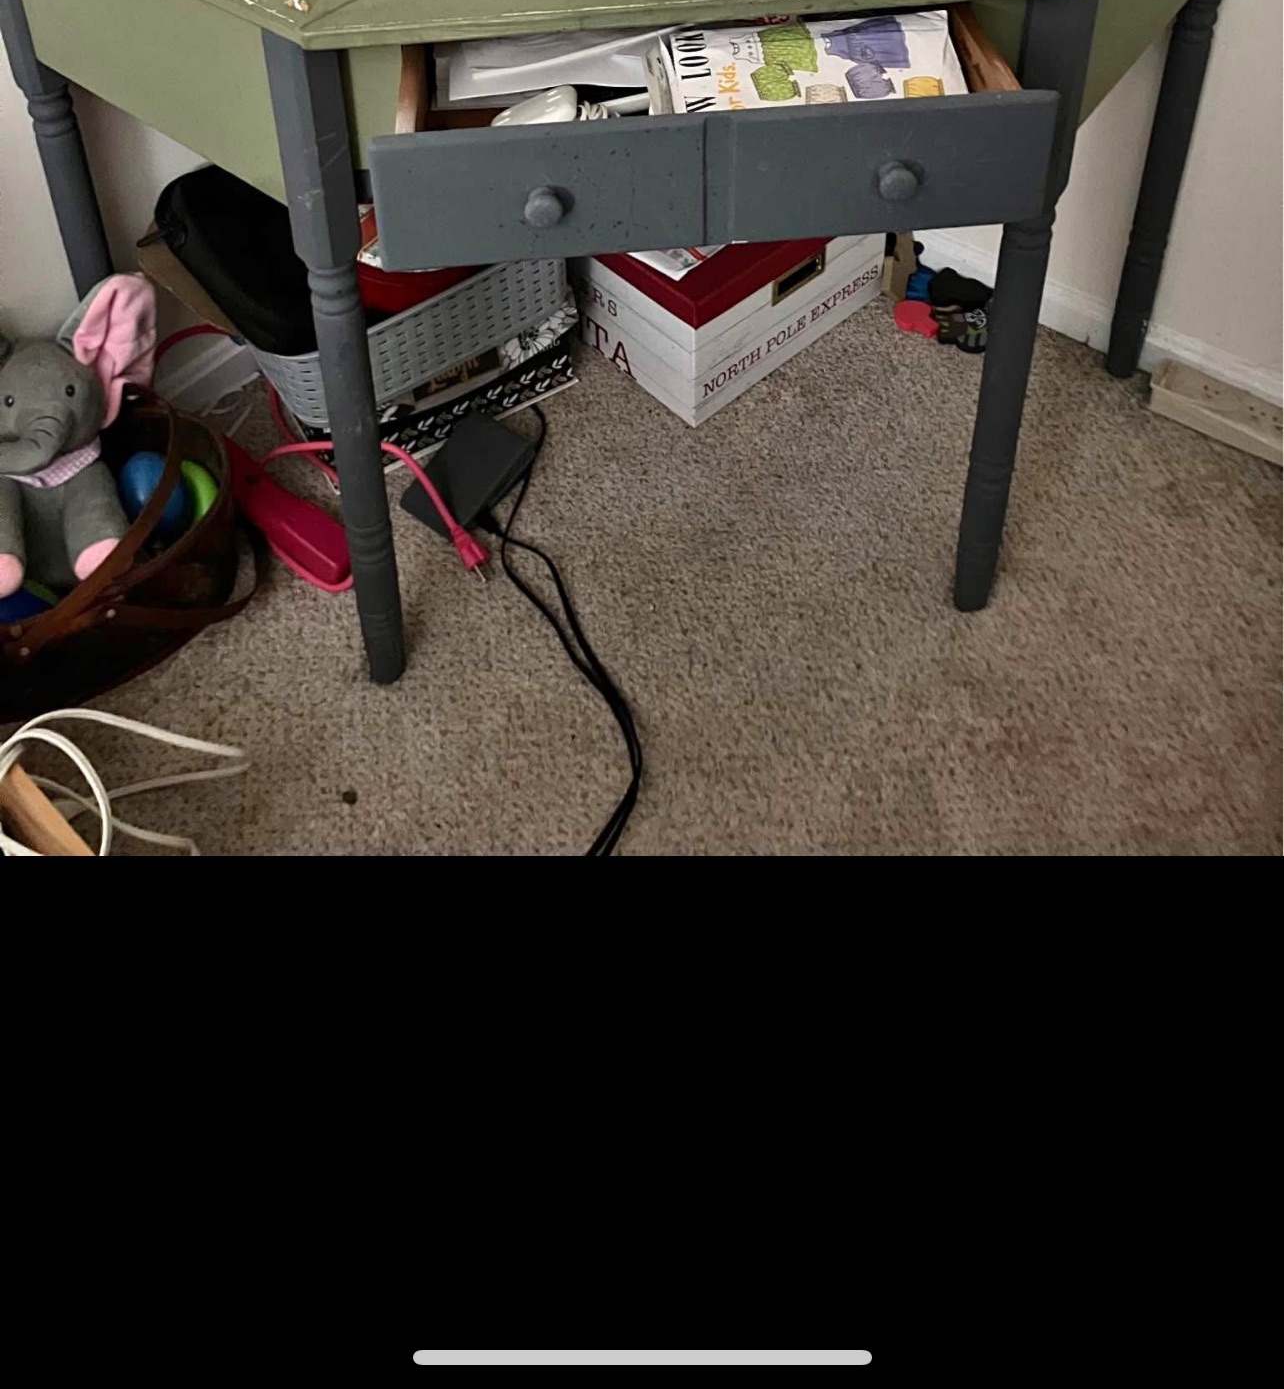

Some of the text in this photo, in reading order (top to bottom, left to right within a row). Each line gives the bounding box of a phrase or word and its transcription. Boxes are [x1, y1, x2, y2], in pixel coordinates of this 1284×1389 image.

[674, 32, 712, 80] LOOK
[586, 315, 637, 381] TA
[702, 265, 880, 399] NORTH POLE EXPRESS
